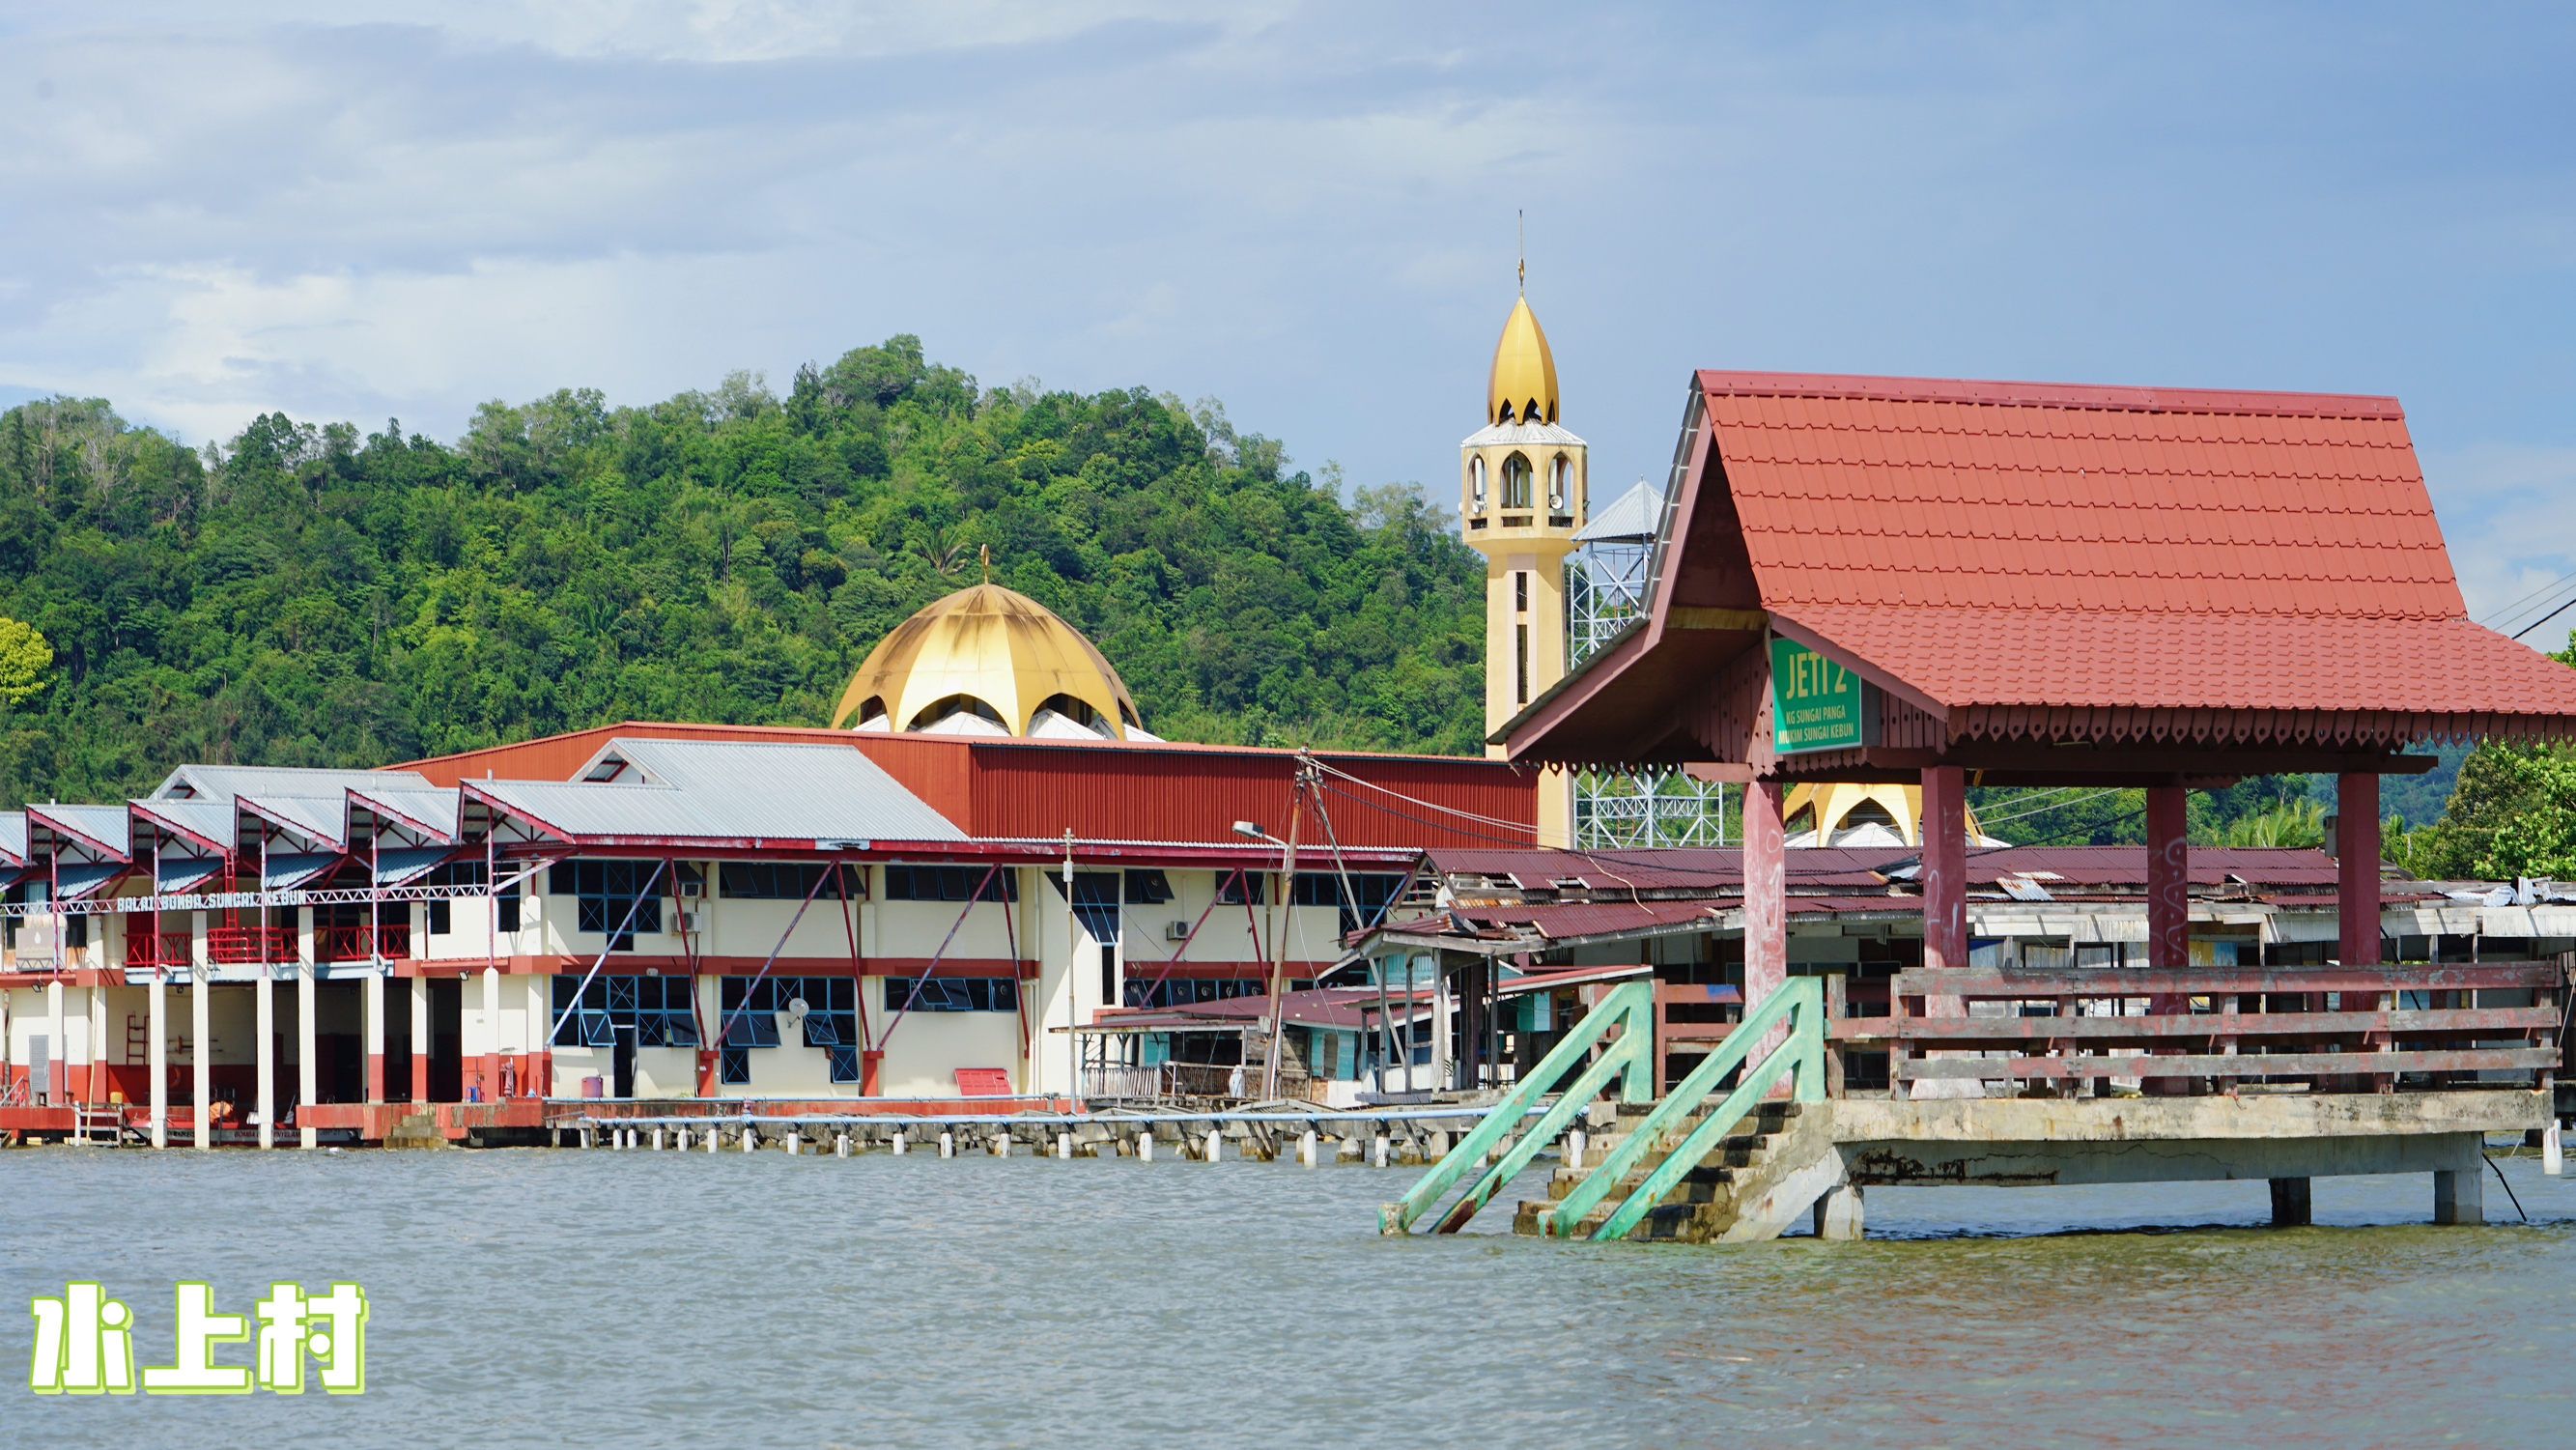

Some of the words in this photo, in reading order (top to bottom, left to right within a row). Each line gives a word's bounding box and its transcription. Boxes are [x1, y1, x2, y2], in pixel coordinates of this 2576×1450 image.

[1786, 651, 1827, 699] JETI
[1786, 711, 1795, 725] KG
[1797, 707, 1822, 725] SUNGAI
[1823, 704, 1846, 721] PANGA
[1778, 728, 1802, 745] MUKIM
[1804, 725, 1829, 741] SUNGAI
[1830, 723, 1854, 738] KEBUN
[117, 896, 155, 913] BALAI
[160, 894, 202, 910] BOMBA
[208, 892, 255, 909] SUNGAI
[264, 889, 306, 906] KEBUN
